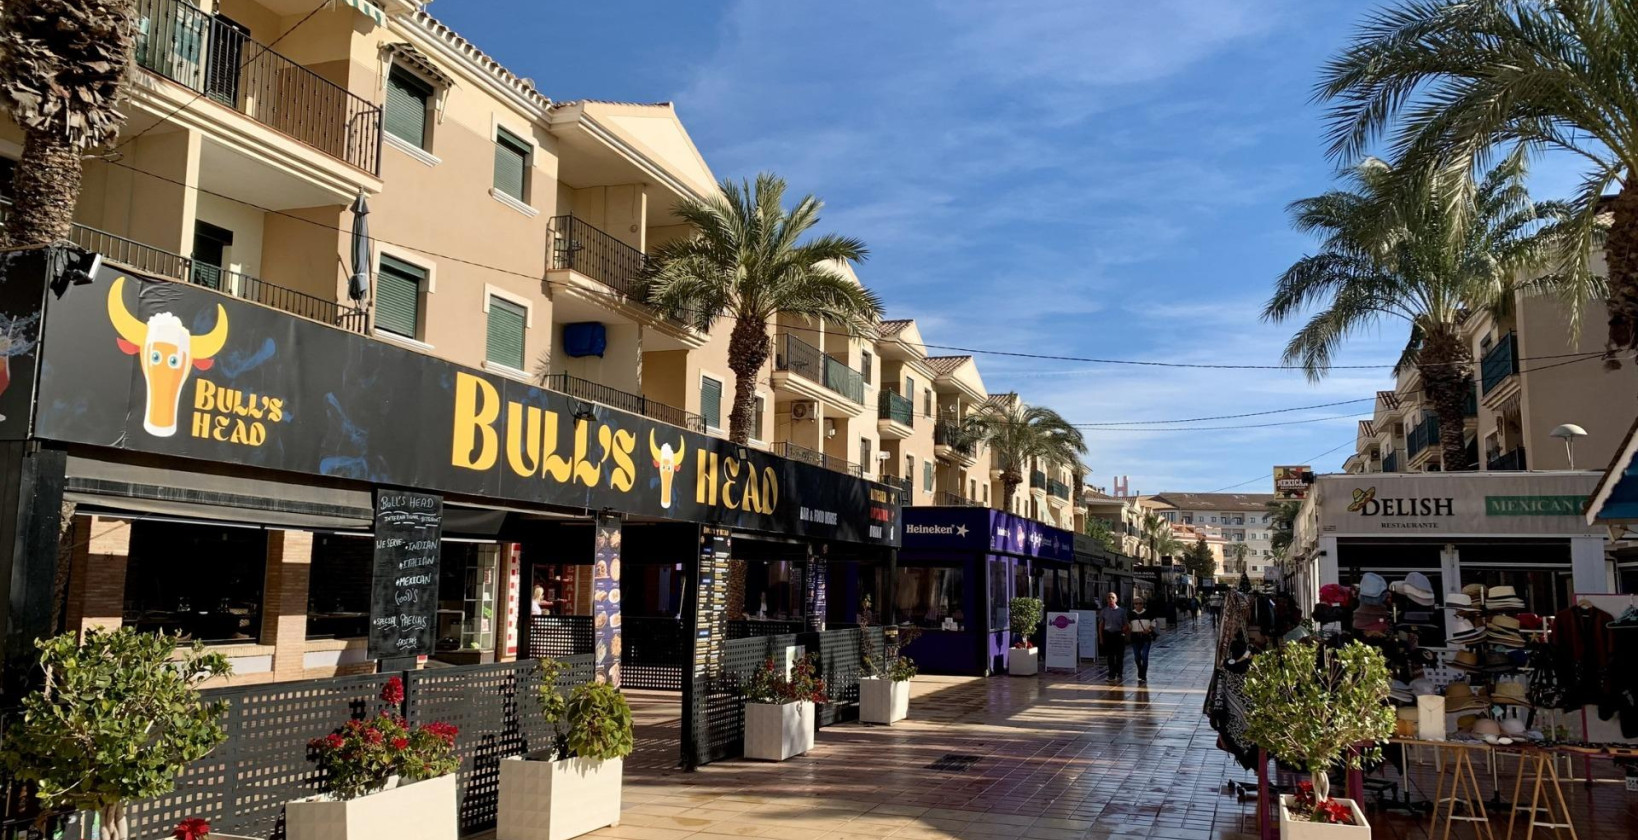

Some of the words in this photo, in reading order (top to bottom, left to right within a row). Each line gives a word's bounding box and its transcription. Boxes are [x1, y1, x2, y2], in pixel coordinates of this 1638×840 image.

[194, 378, 283, 422] BULL'S
[192, 411, 266, 446] HEAD
[451, 371, 636, 492] BULL'S
[696, 448, 778, 515] HEAD
[1278, 479, 1308, 487] MEXICA
[409, 496, 434, 508] HEAD
[1361, 498, 1455, 516] DELISH
[1492, 499, 1574, 512] MEXICAN
[814, 509, 825, 523] FOOD
[906, 524, 953, 534] Heineken
[376, 540, 386, 549] WE
